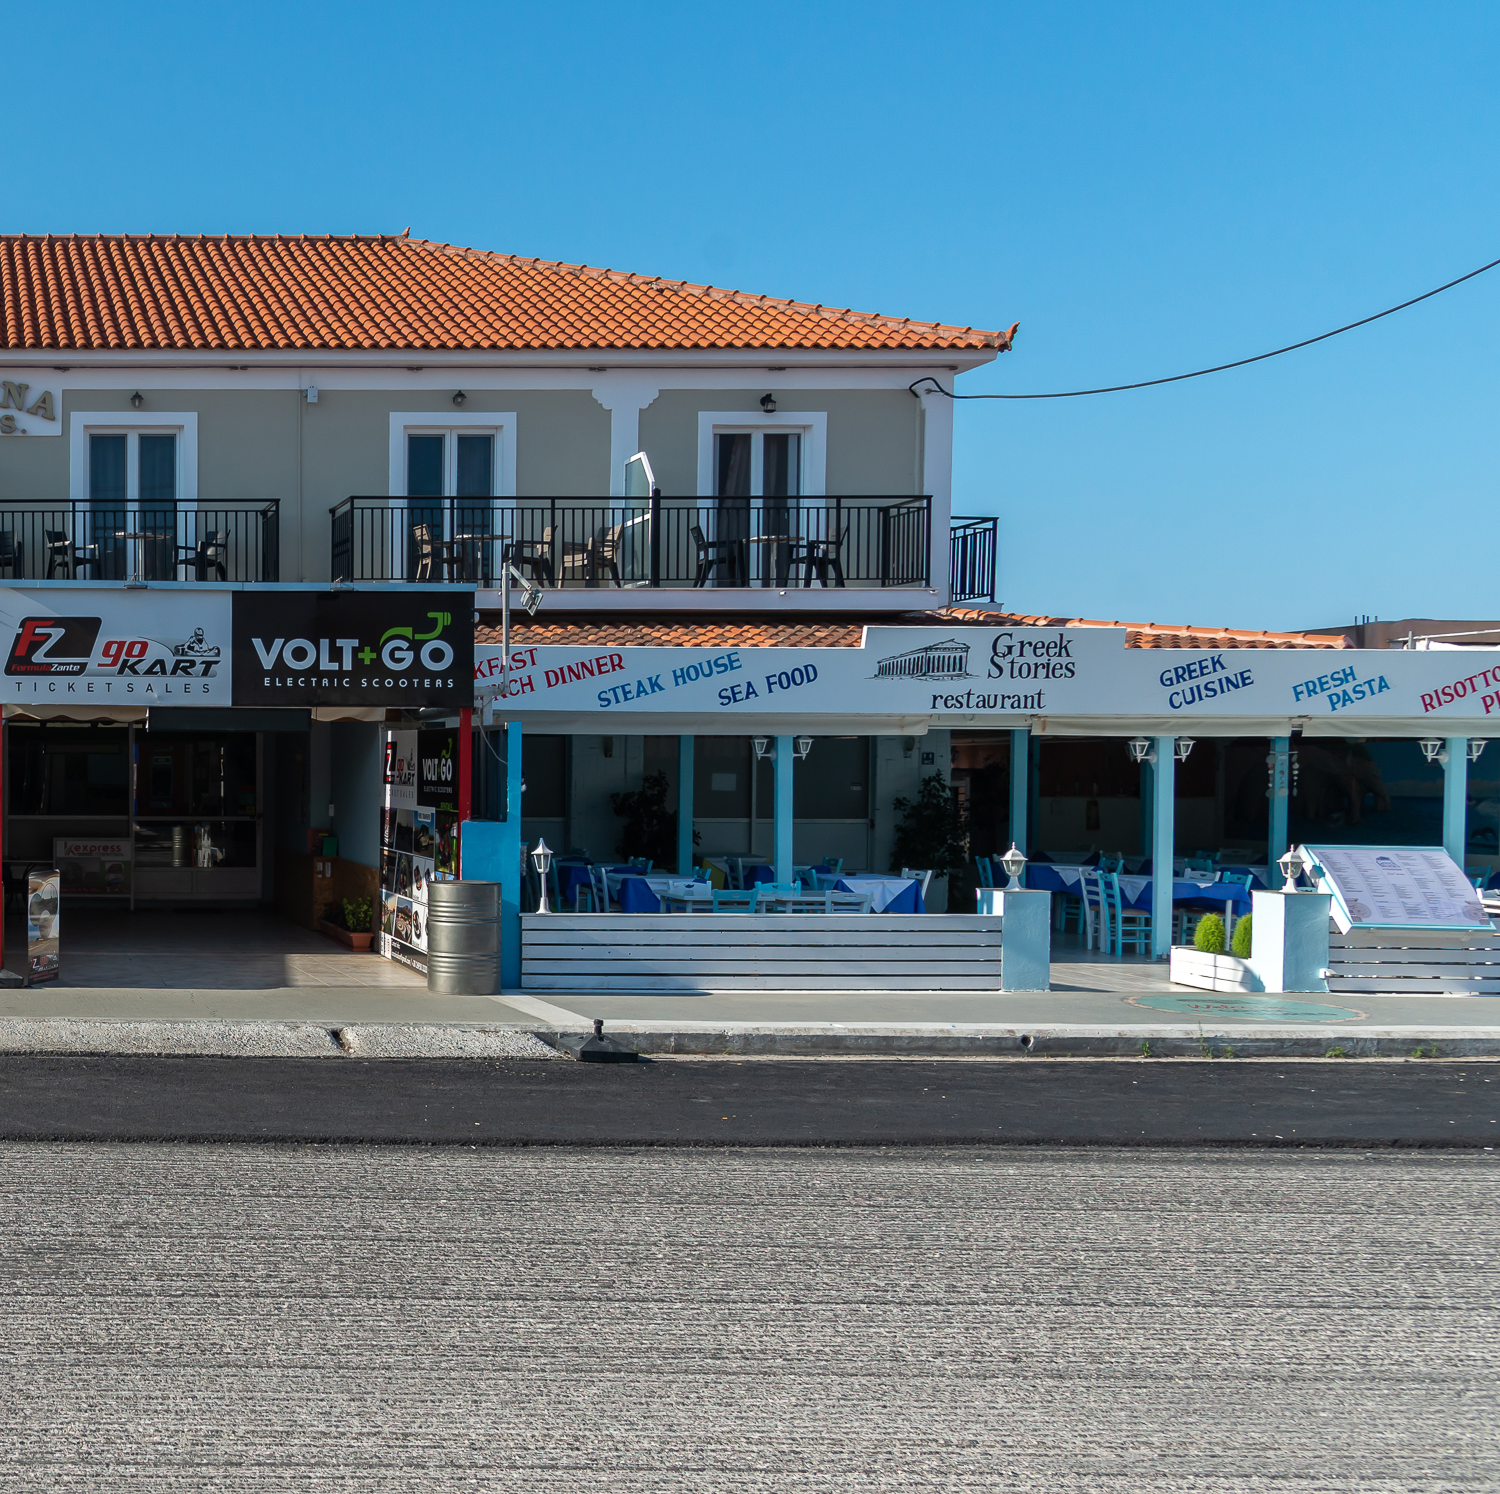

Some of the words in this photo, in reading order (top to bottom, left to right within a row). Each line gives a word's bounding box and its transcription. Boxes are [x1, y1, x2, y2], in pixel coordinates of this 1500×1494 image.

[97, 640, 149, 668] go
[991, 632, 1074, 660] Greek
[116, 658, 222, 677] KART
[544, 653, 626, 689] DINNER
[597, 673, 665, 708] STEAK
[672, 652, 742, 687] HOUSE
[987, 651, 1075, 679] Stories
[1159, 653, 1227, 687] GREEK
[264, 677, 350, 687] ELECTRIC
[361, 678, 454, 688] SCOOTERS
[718, 681, 759, 706] SEA
[765, 663, 818, 694] FOOD
[930, 688, 1046, 710] restaurant
[1168, 668, 1254, 710] CUISINE
[1291, 665, 1357, 702] FRESH
[1326, 675, 1391, 712] PASTA
